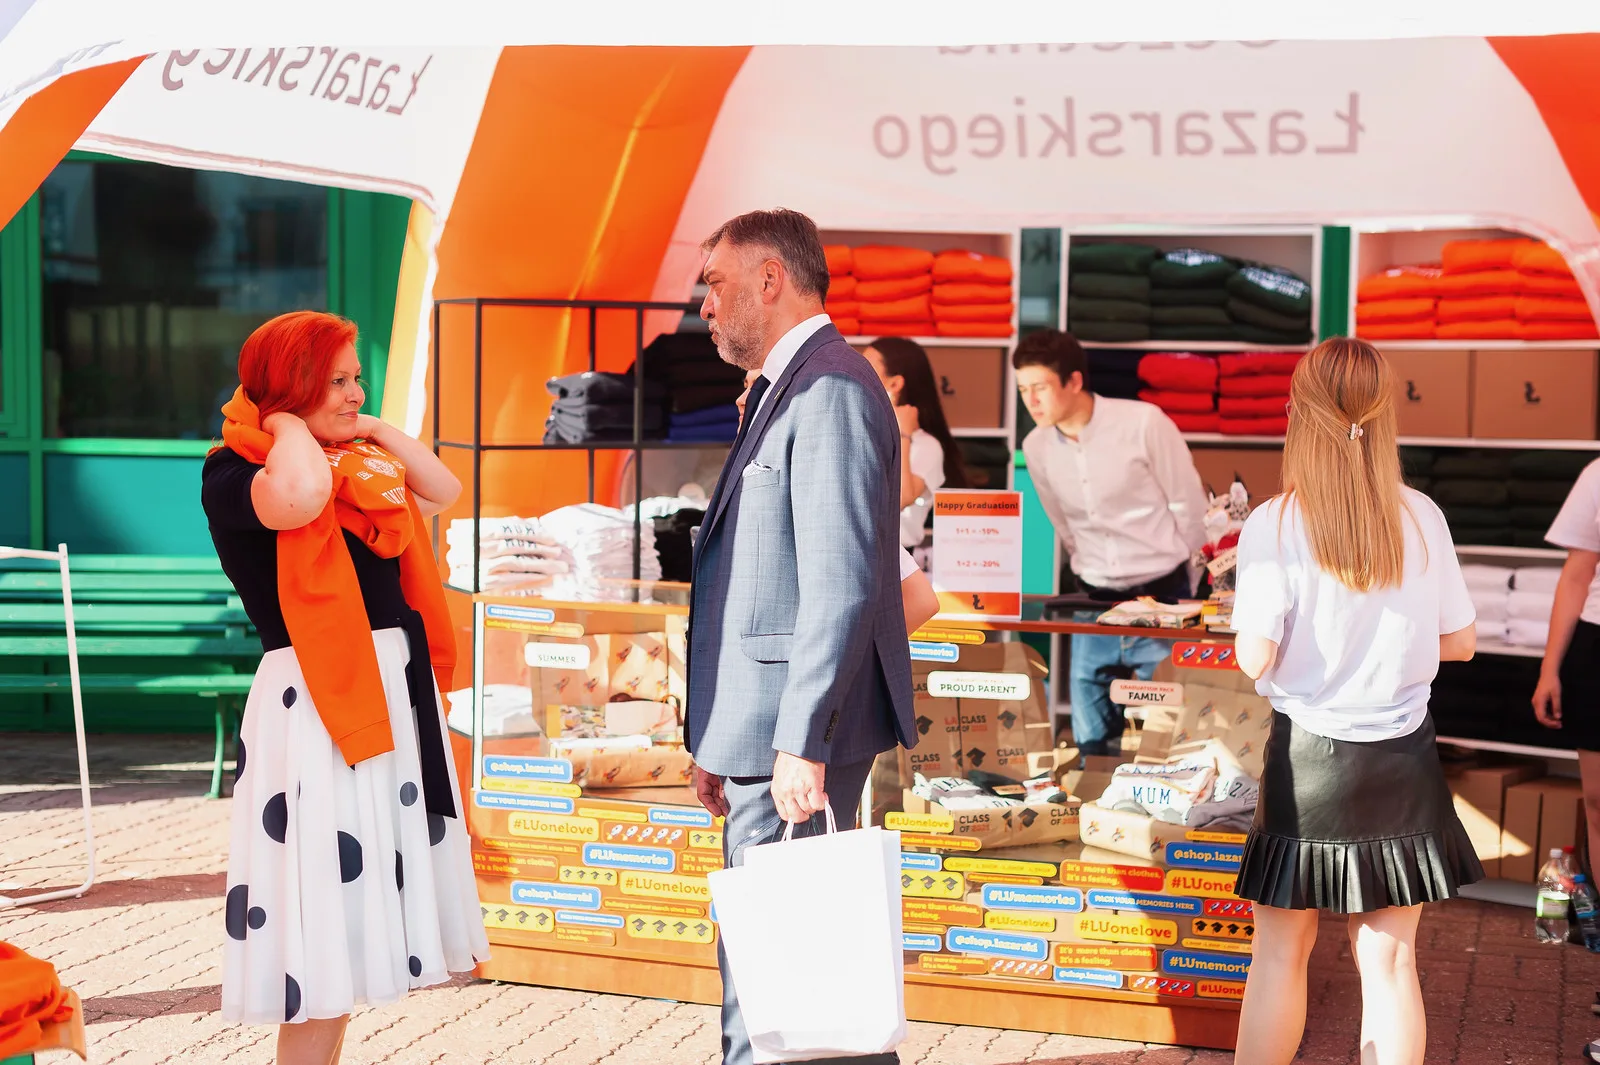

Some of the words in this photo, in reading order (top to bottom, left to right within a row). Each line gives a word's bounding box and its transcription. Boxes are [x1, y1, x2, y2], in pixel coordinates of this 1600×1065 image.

[937, 502, 964, 510] Happy
[966, 502, 1018, 510] Graduation!
[538, 654, 576, 663] SUMMER
[940, 683, 975, 692] PROUD
[978, 685, 1017, 694] PARENT
[1128, 692, 1166, 702] FAMILY
[910, 753, 940, 763] CLASS
[997, 748, 1024, 757] CLASS
[1132, 786, 1171, 805] MUM
[1050, 807, 1079, 817] CLASS
[889, 817, 950, 828] #LUonelove
[959, 814, 990, 824] CLASS
[513, 819, 594, 835] #LUonelove
[625, 877, 708, 895] #LUonelove
[988, 889, 1077, 906] #LUmemories
[1136, 898, 1174, 908] MEMORIES
[1175, 901, 1194, 910] HERE
[989, 916, 1050, 928] #LUonelove
[1080, 919, 1172, 938] #LUonelove
